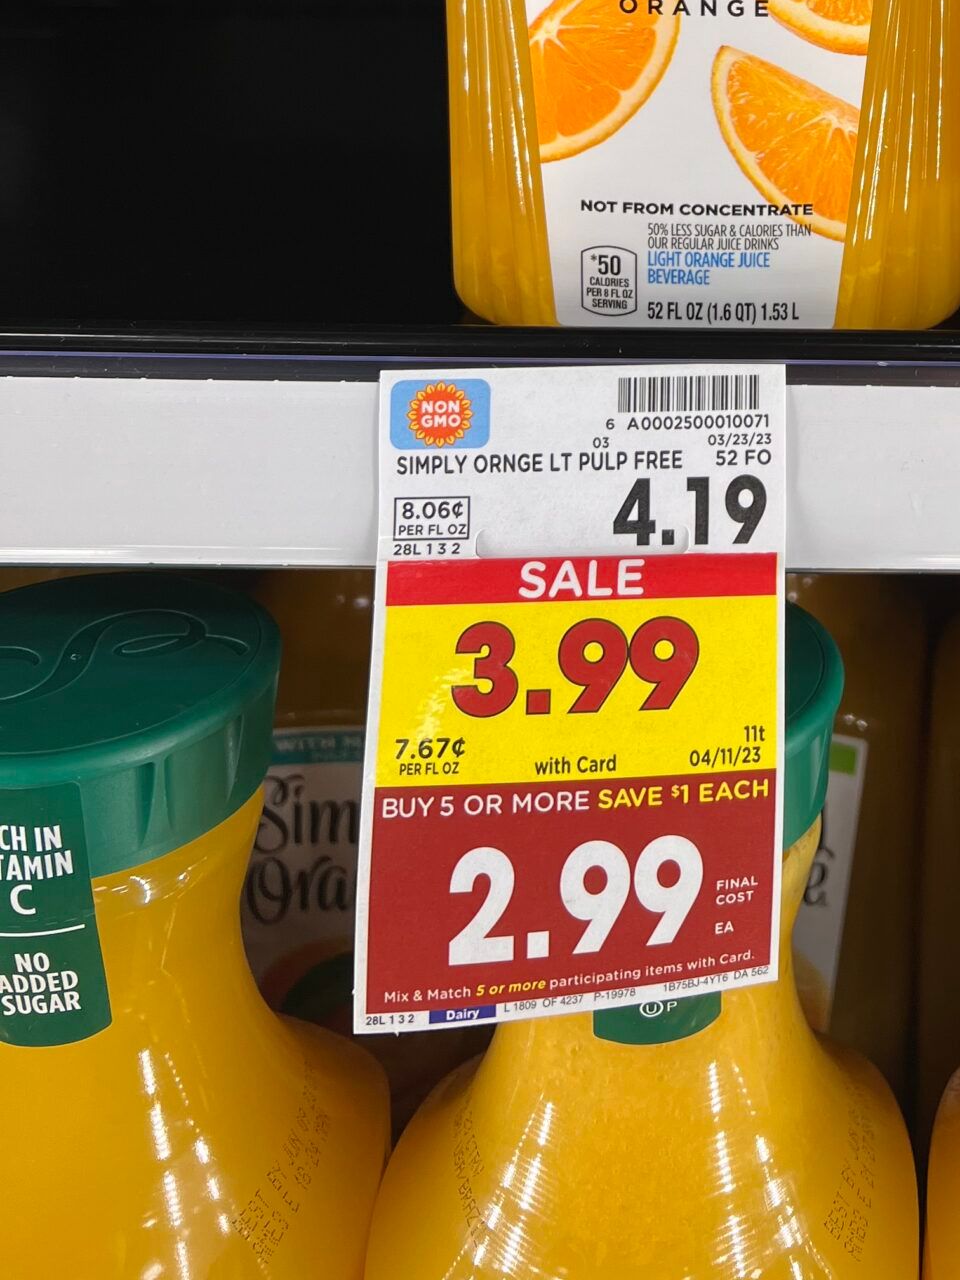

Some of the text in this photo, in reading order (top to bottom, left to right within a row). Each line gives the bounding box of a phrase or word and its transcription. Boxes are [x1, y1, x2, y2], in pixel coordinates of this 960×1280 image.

[580, 200, 813, 216] NOT FROM CONCENTRATE
[647, 223, 811, 237] 50% LESS SUGAR & CALORIES THAN
[647, 237, 779, 251] OUR REGULAR JUICE DRINKS
[647, 252, 770, 268] LIGHT ORANGE JUICE
[589, 276, 629, 288] CALORIES
[647, 268, 710, 285] BEVERAGE
[586, 287, 633, 299] PER 8 FL OZ
[592, 298, 627, 309] SERVING
[647, 302, 799, 325] 52 FL OZ (1.6 QT) 1.53 L
[422, 400, 460, 415] NON
[421, 414, 461, 428] GMO
[605, 414, 770, 431] 6 A0002500010071
[592, 434, 772, 449] 03 03/23/23
[396, 449, 771, 476] SIMPLY ORNGE LT PULP FREE 52 FO
[401, 501, 464, 520] 8.06¢
[613, 474, 768, 546] 4.19
[398, 522, 466, 536] PER FL OZ
[393, 542, 460, 556] 28L 1 3 2
[518, 559, 645, 598] SALE
[451, 616, 700, 718] 3.99
[395, 737, 466, 760] 7.67¢
[399, 761, 459, 775] PER FL OZ
[535, 747, 762, 775] with Card 04/11/23
[382, 778, 769, 819] BUY 5 OR MORE SAVE $1 EACH
[34, 825, 62, 852] IN
[716, 875, 758, 892] FINAL
[10, 884, 36, 915] C
[448, 834, 704, 966] 2.99
[716, 890, 754, 906] COST
[714, 921, 734, 935] EA
[14, 952, 50, 973] NO
[0, 970, 79, 993] ADDED
[384, 950, 755, 1004] Mix & Match 5 or more participating items with Card.
[3, 991, 81, 1016] SUGAR
[366, 1014, 387, 1026] 28L
[398, 1014, 405, 1024] 3
[407, 1013, 415, 1024] 2
[446, 1007, 480, 1023] Dairy
[504, 1002, 510, 1013] L
[514, 999, 538, 1011] 1809
[542, 996, 557, 1008] OF
[560, 994, 584, 1007] 4237
[593, 988, 636, 1003] P-19978
[733, 970, 749, 983] DA
[750, 965, 769, 980] 562
